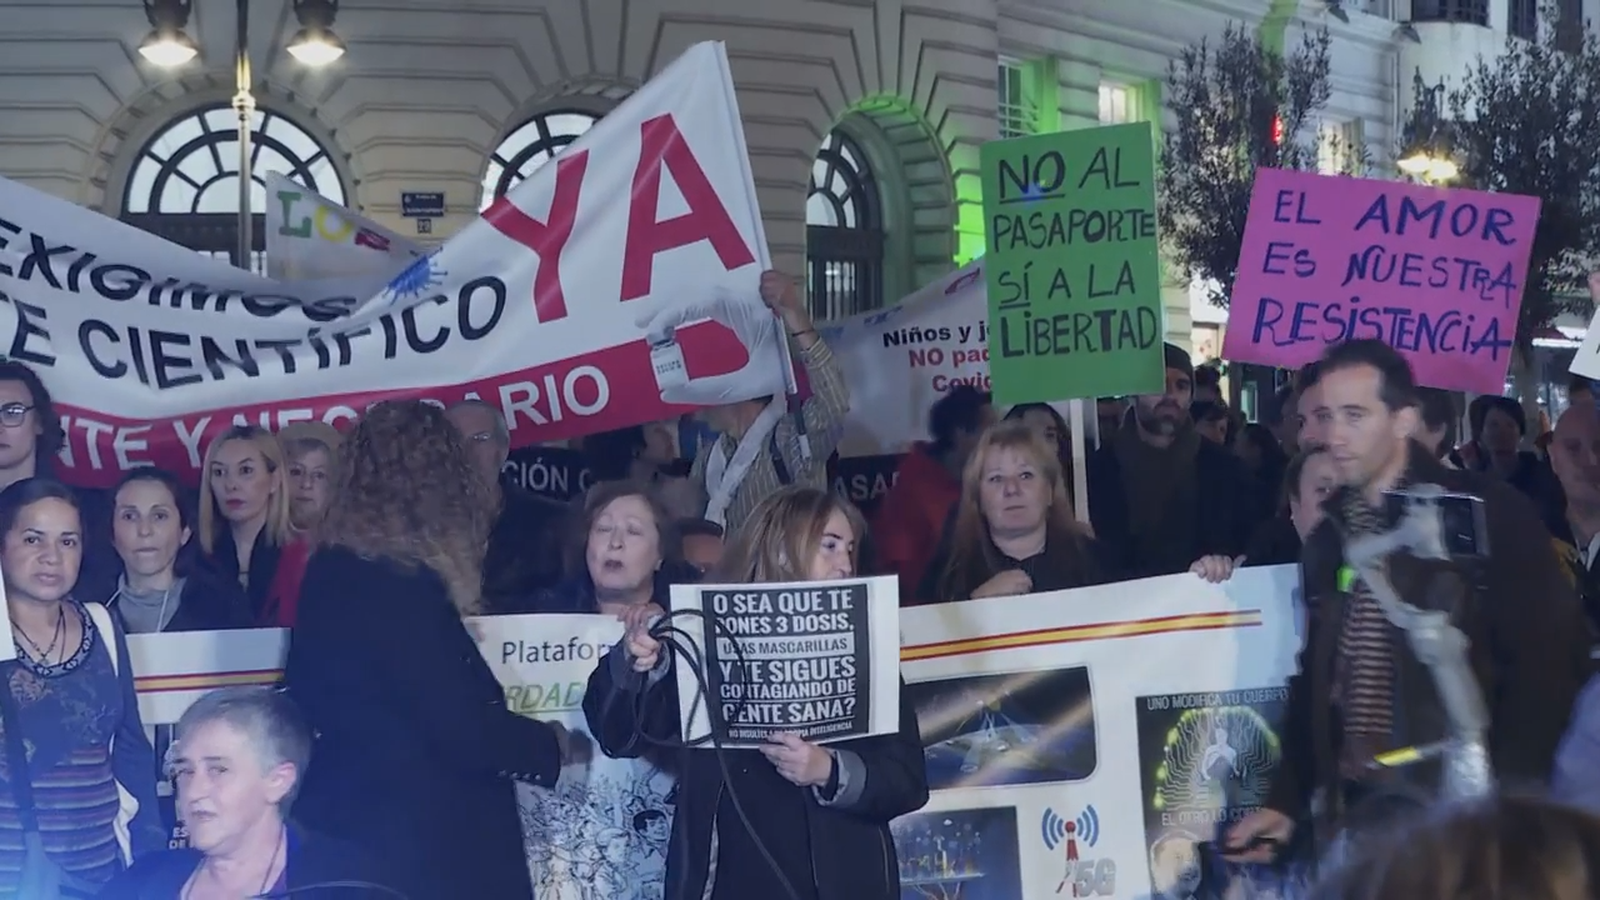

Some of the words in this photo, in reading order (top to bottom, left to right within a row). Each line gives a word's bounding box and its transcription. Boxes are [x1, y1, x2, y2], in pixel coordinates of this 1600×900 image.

[999, 151, 1066, 199] NO
[1078, 146, 1141, 190] AL
[480, 112, 756, 324] YA
[993, 208, 1155, 252] PASAPORTE
[1274, 190, 1321, 224] EL
[1354, 194, 1517, 245] AMOR
[998, 260, 1034, 304] SÍ
[1048, 267, 1071, 300] A
[1088, 260, 1135, 298] LA
[1262, 242, 1317, 277] ES
[1341, 245, 1517, 309] NUESTRA
[883, 325, 951, 347] Niños
[958, 325, 971, 343] y
[908, 347, 944, 368] NO
[172, 416, 212, 469] Y
[713, 594, 728, 614] O
[733, 593, 773, 614] SEA
[778, 591, 824, 615] QUE
[827, 589, 853, 610] TE
[776, 616, 788, 633] 3
[723, 642, 756, 655] UAS
[759, 638, 847, 655] MASCARILLAS
[719, 661, 732, 682] Y
[768, 656, 856, 682] SIGUES
[837, 678, 856, 694] DE
[788, 697, 856, 721] SANA?
[1147, 696, 1169, 710] UNO
[1226, 692, 1240, 705] TU
[1076, 858, 1117, 898] 5G
